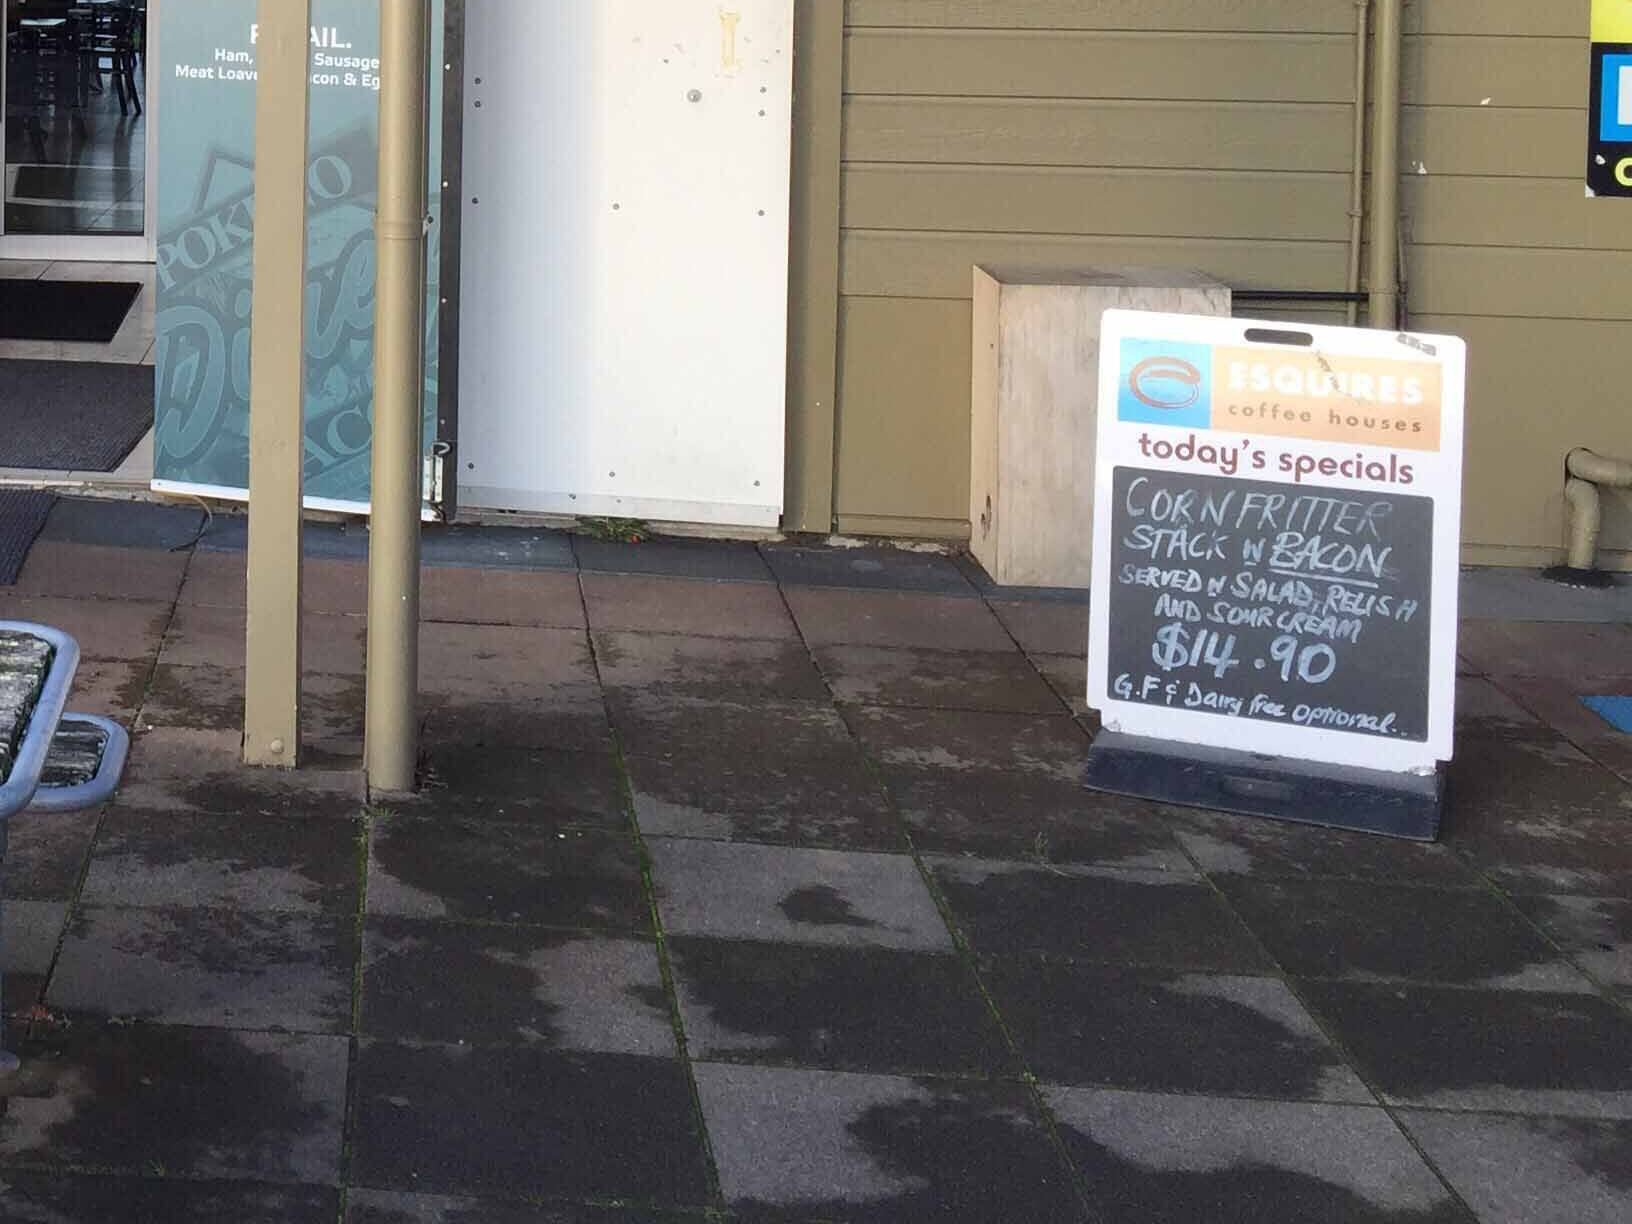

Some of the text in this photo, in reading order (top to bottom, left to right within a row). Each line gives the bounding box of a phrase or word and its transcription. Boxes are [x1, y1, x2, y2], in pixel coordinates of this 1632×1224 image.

[175, 64, 214, 79] Meat
[218, 66, 258, 81] Loav
[309, 74, 339, 85] con
[344, 73, 356, 86] &
[215, 48, 253, 64] Ham,
[1227, 360, 1424, 406] ESQUIRES
[1228, 401, 1422, 432] coffee houses
[1138, 433, 1414, 484] today's specials
[1126, 476, 1392, 540] CORN FRITTER
[1123, 524, 1228, 561] STACK
[1269, 531, 1392, 578] BACON
[1119, 563, 1202, 592] SERVED
[1154, 592, 1202, 622] AND
[1276, 610, 1362, 644] CREAM
